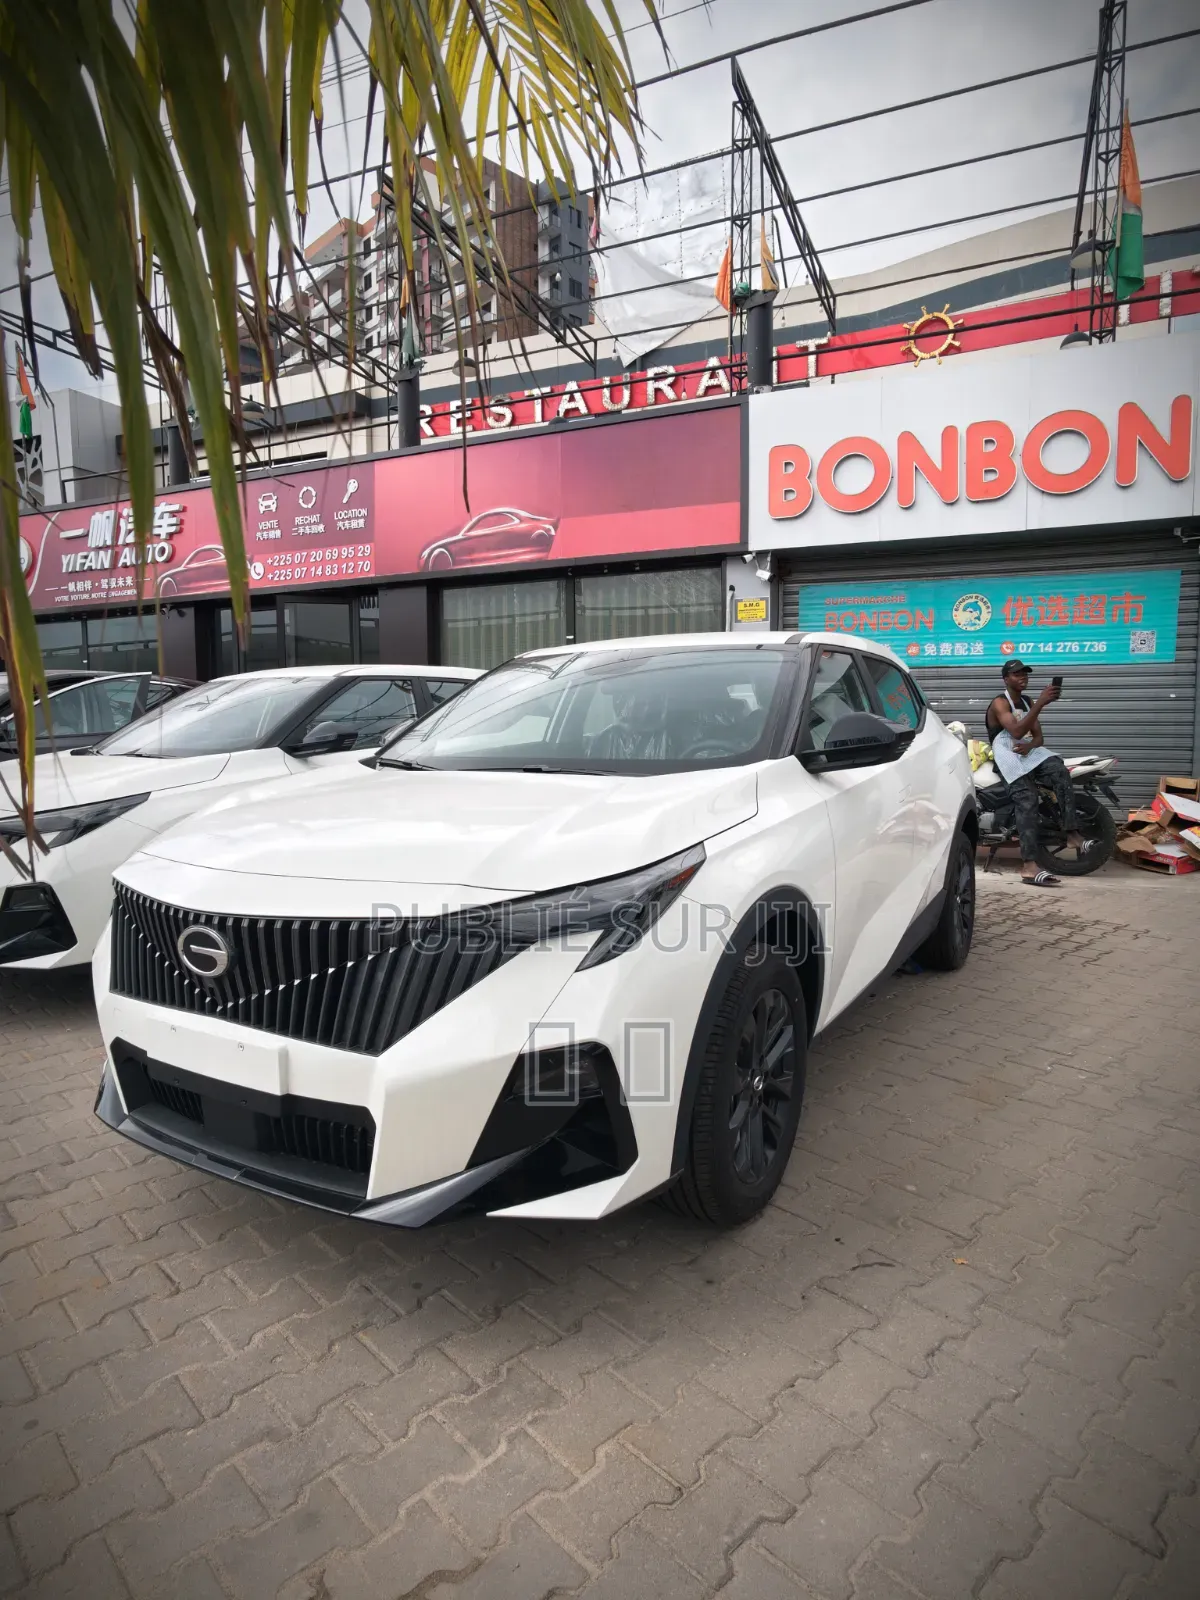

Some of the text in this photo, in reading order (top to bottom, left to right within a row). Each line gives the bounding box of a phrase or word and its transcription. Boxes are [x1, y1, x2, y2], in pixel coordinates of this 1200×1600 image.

[420, 337, 829, 437] RESTAURAT
[768, 394, 1193, 519] BONBON
[294, 514, 321, 526] RECHAT
[334, 508, 368, 520] LOCATION
[258, 520, 279, 530] VENTE
[61, 550, 113, 573] YIFAN
[266, 544, 371, 567] +225 07 20 69 95 29
[267, 560, 371, 581] +225 07 14 83 12 70
[108, 588, 138, 598] ENGAGEMEN
[1000, 591, 1147, 627] 优选超市
[824, 608, 935, 633] BONBON
[923, 642, 984, 656] 免费配送
[1018, 641, 1107, 653] 07 14 276 736
